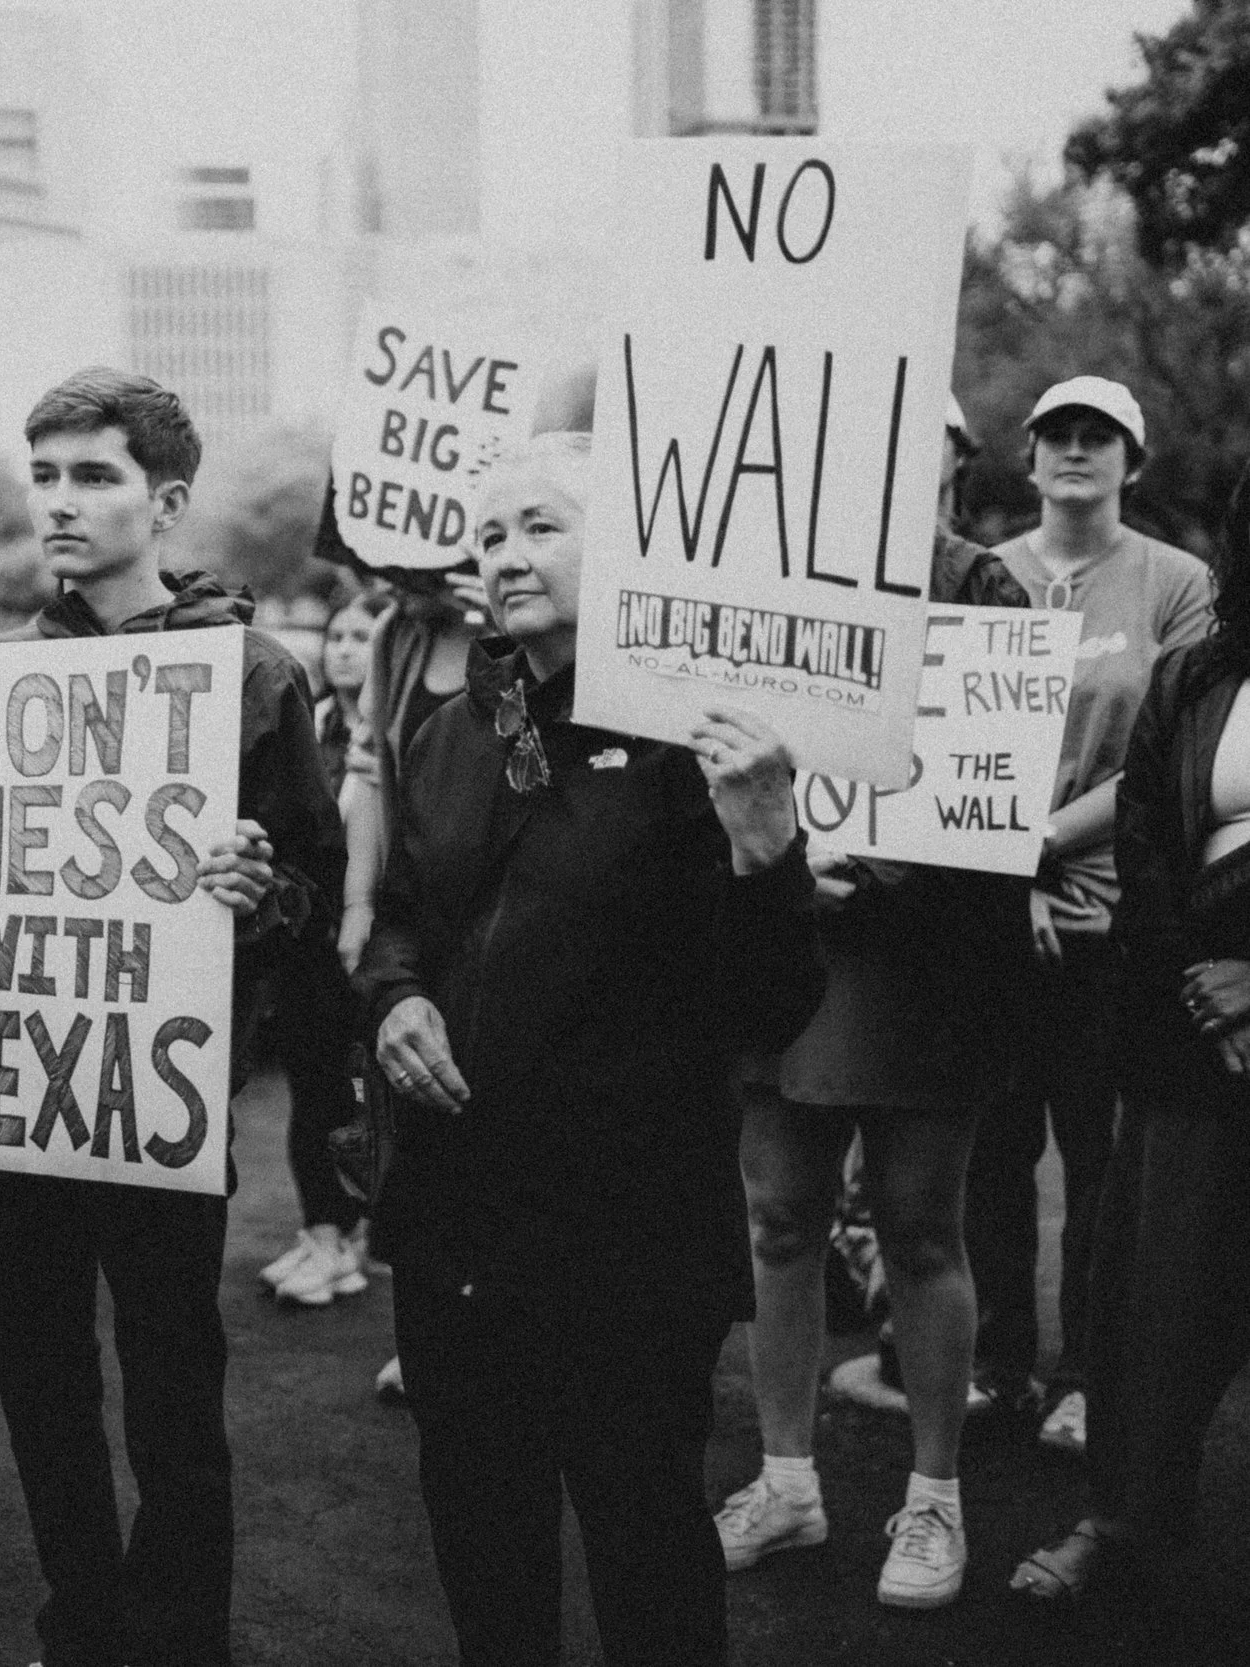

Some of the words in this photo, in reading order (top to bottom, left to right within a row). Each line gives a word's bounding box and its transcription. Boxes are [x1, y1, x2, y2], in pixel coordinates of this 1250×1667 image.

[704, 158, 837, 265] NO
[363, 325, 519, 416] SAVE
[379, 408, 461, 472] BIG
[623, 333, 923, 599] WALL
[347, 470, 467, 548] BEND
[668, 598, 712, 655] BIG
[716, 606, 788, 665] BEND
[793, 617, 884, 689] WALL!
[979, 618, 1053, 658] THE
[627, 652, 867, 707] NO-AL-MUROCOM
[961, 671, 1068, 716] RIVER
[948, 752, 1017, 782] THE
[934, 793, 1031, 832] WALL
